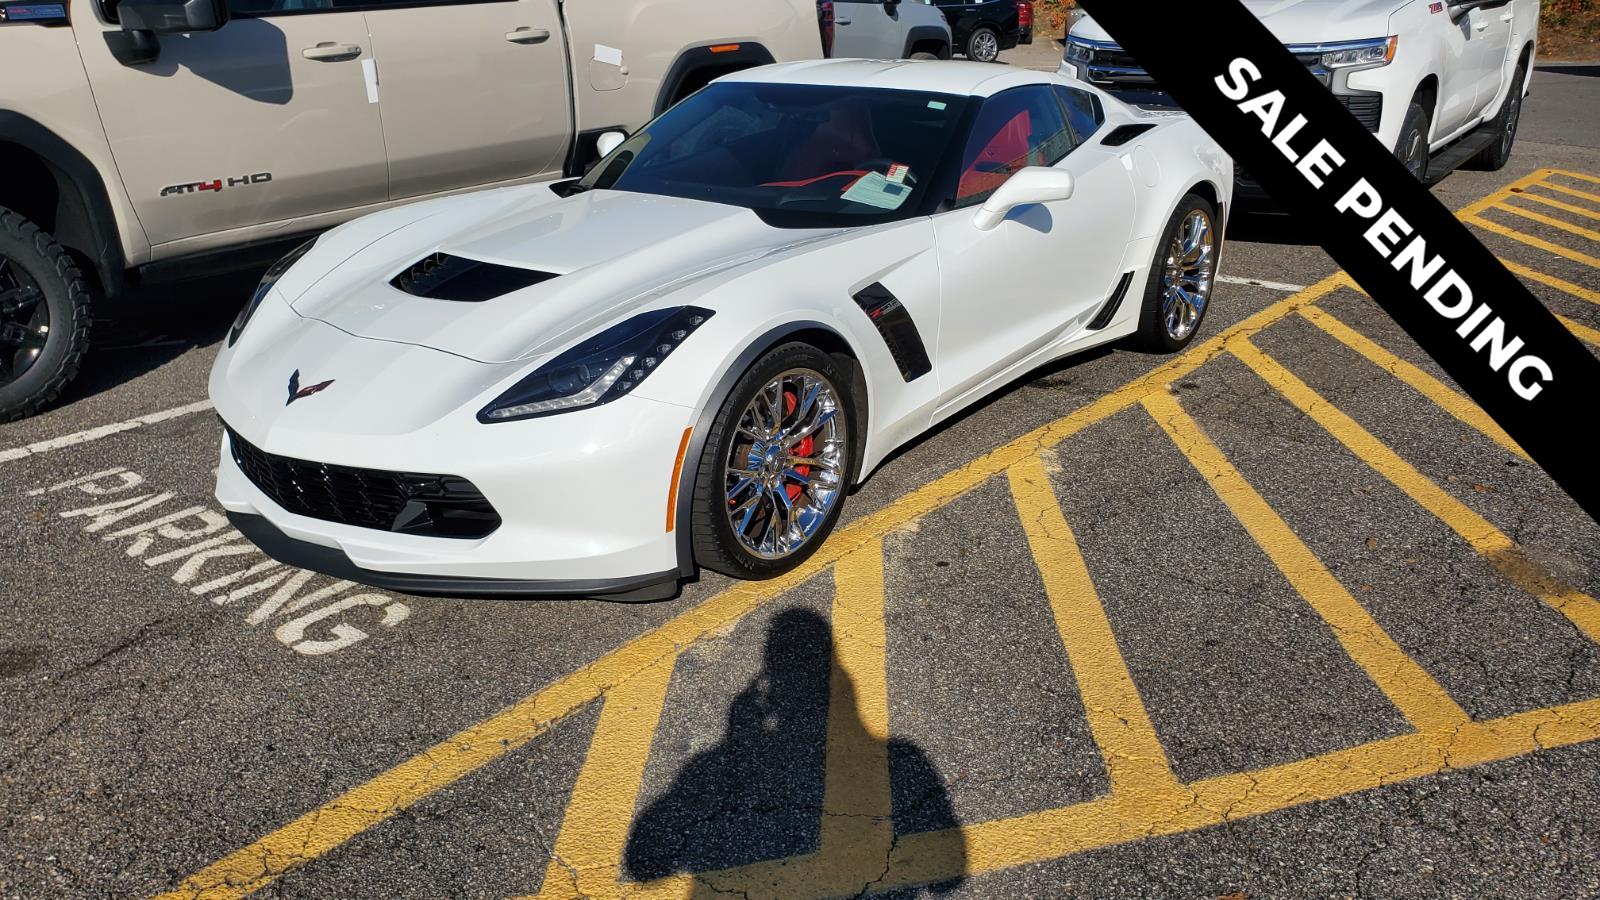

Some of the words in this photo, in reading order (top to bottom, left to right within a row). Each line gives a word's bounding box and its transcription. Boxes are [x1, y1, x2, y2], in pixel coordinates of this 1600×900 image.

[160, 179, 222, 197] AT4
[228, 173, 272, 187] HD
[26, 466, 411, 656] PARKING
